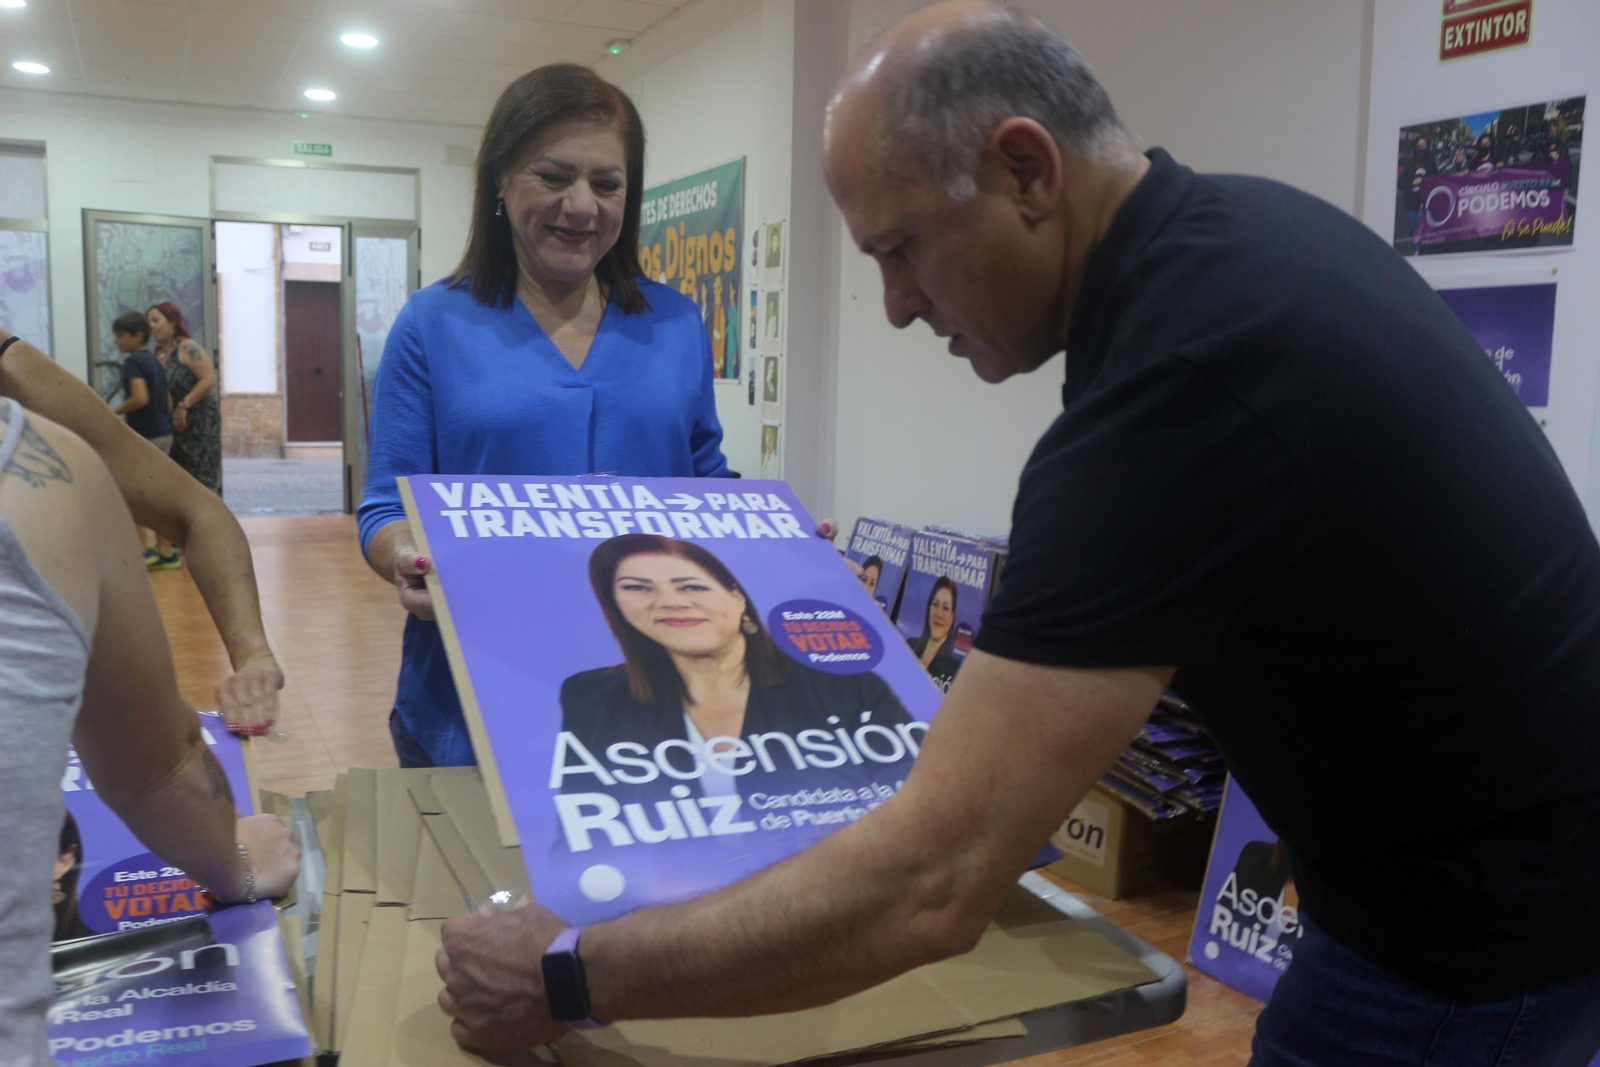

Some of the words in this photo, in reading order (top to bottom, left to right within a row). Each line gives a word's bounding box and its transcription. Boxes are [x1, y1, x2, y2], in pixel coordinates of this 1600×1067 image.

[1444, 9, 1527, 50] EXTINTOR
[657, 196, 669, 221] DE
[669, 181, 717, 218] DERECHOS
[1457, 188, 1551, 218] PODEMOS
[665, 221, 736, 294] Dignos
[430, 482, 668, 511] VALENTÍA
[702, 492, 793, 512] PARA
[440, 509, 811, 540] TRANSFORMAR
[913, 537, 957, 563] VALENTÍA
[965, 554, 988, 571] PARA
[912, 554, 987, 590] TRANSFORMAR
[788, 632, 872, 652] VOTAR
[808, 652, 871, 663] Podemos
[548, 711, 929, 790] Ascensión
[748, 786, 858, 810] Candidata
[553, 785, 758, 853] Ruiz
[759, 812, 793, 831] de
[790, 805, 869, 827] Puerto
[104, 884, 129, 898] TÚ
[114, 870, 158, 883] Este
[104, 890, 216, 919] VOTAR
[1209, 902, 1279, 965] Ruiz
[82, 993, 110, 1006] la
[116, 981, 239, 1003] Alcaldía
[52, 1003, 134, 1025] Real
[47, 1019, 258, 1058] Podemos
[145, 1038, 208, 1058] Real
